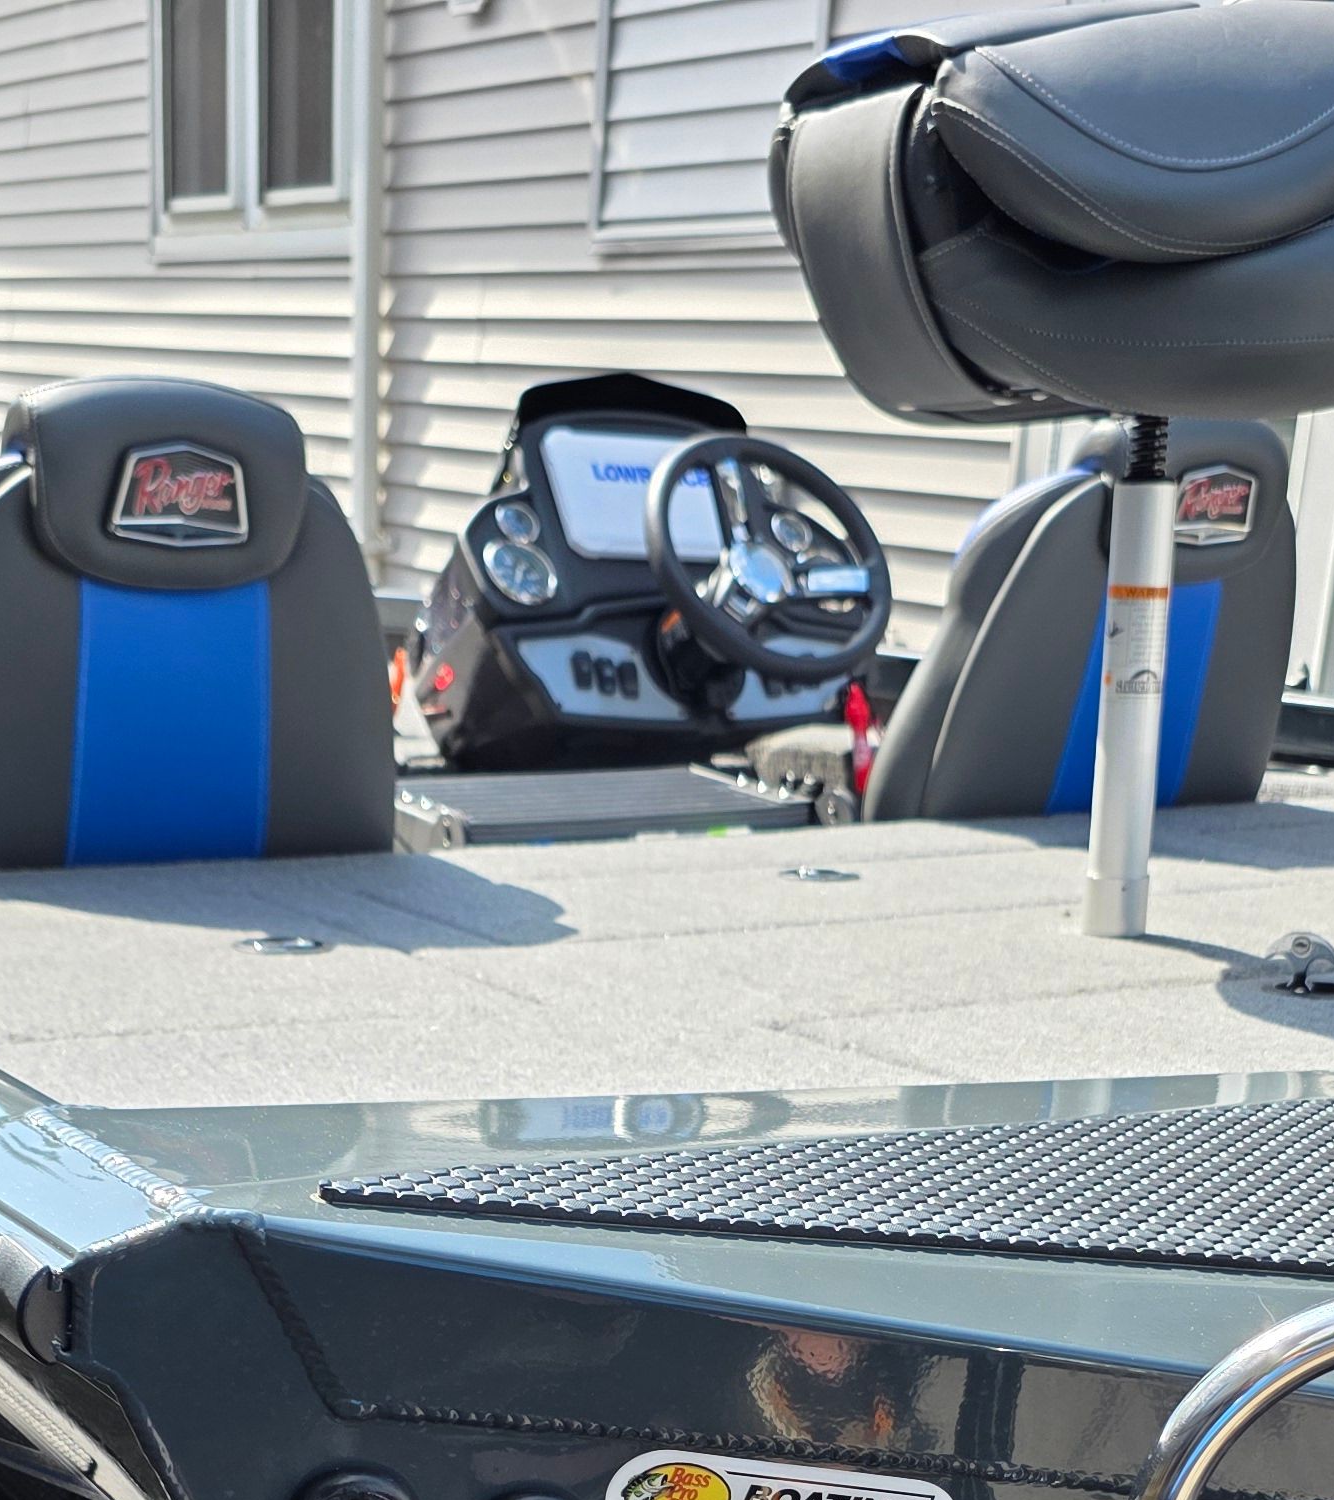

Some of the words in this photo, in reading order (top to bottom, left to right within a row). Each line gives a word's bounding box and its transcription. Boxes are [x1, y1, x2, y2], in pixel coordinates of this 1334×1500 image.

[592, 464, 710, 486] LOWRCE
[133, 457, 235, 516] Ranger
[668, 1467, 711, 1488] Bass
[666, 1484, 698, 1500] Pro
